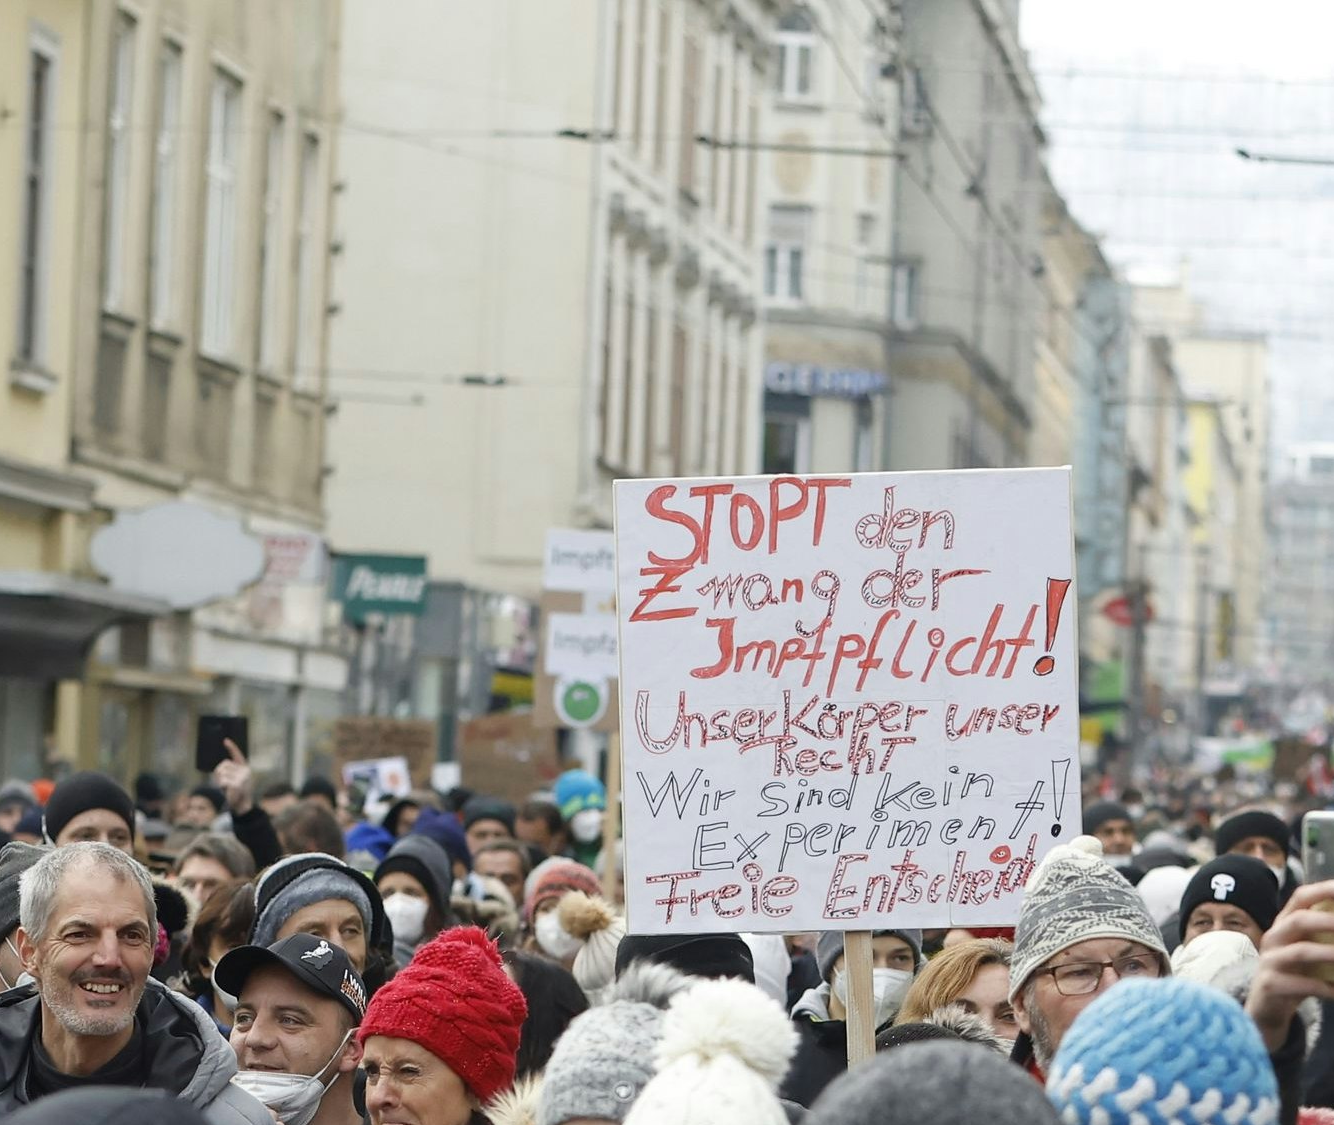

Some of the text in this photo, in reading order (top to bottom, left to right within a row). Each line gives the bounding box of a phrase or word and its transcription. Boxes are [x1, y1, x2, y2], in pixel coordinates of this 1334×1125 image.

[645, 477, 956, 567] STOPT den
[629, 552, 991, 637] Zwang der
[636, 768, 736, 820] Wir
